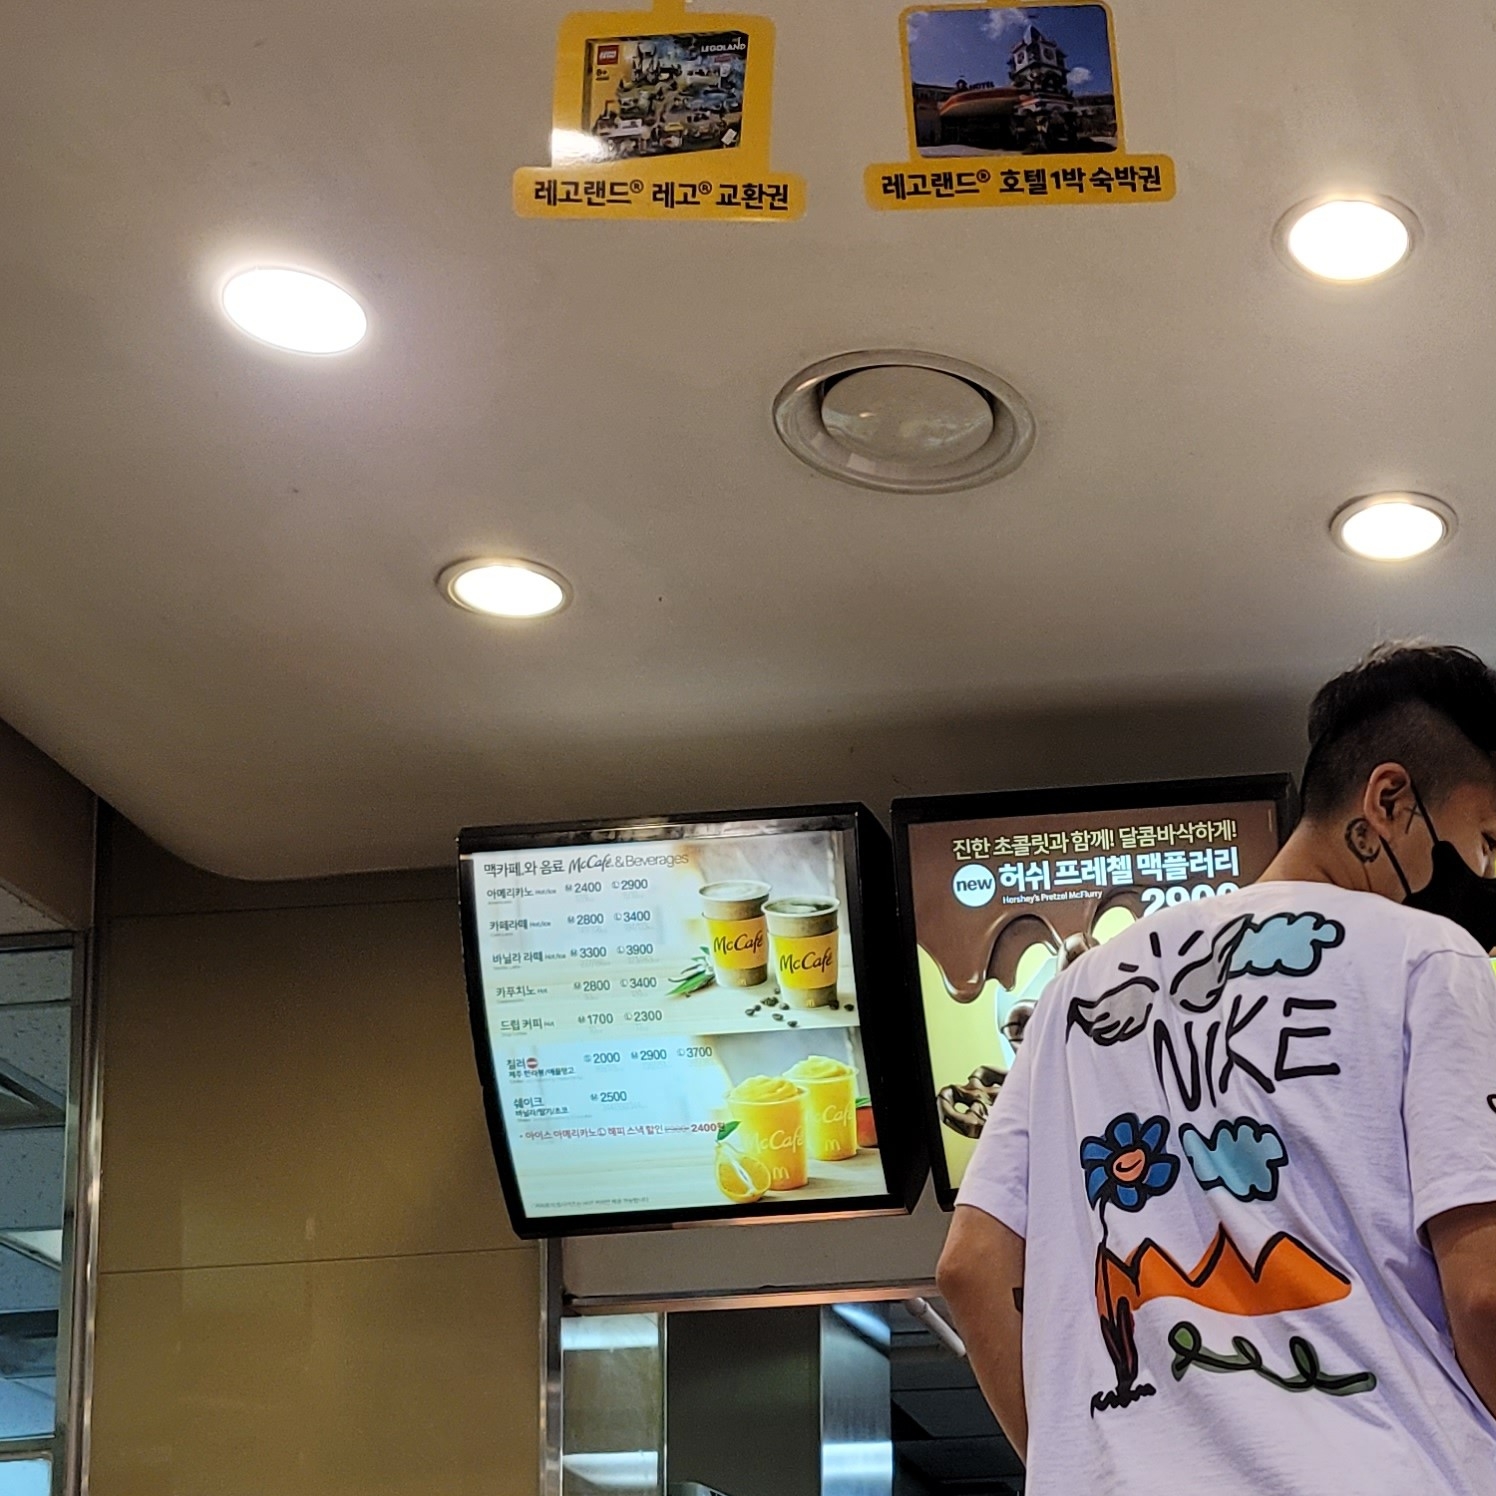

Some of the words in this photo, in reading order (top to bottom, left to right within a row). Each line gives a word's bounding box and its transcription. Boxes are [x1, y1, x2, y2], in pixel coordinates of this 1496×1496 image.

[1000, 168, 1048, 195] 호텔
[1050, 169, 1086, 194] 1박
[1089, 166, 1161, 195] 숙박권
[715, 183, 789, 211] 교환권
[952, 836, 991, 861] 진한
[992, 833, 1069, 857] 초콜릿과
[1071, 828, 1115, 852] 함께!
[1118, 818, 1238, 849] 달콤바삭하게!
[540, 860, 564, 875] 음료
[625, 853, 689, 868] Beverages
[998, 859, 1050, 892] 허쉬
[1053, 853, 1134, 886] 프레첼
[1136, 846, 1239, 882] 맥플러리
[487, 887, 534, 899] 아메리카노
[574, 882, 602, 893] 2400
[621, 879, 649, 890] 2900
[956, 875, 993, 892] new
[1002, 893, 1040, 905] Hershey's
[1040, 891, 1068, 902] Pretzel
[1068, 890, 1102, 900] McFlurry
[489, 919, 528, 931] 카페라떼
[577, 913, 604, 925] 2800
[623, 910, 651, 922] 3400
[713, 931, 763, 954] McCafé
[492, 952, 521, 965] 바닐라
[523, 951, 543, 962] 라떼
[579, 946, 607, 958] 3300
[626, 944, 653, 955] 3900
[779, 947, 834, 974] McCafé
[496, 985, 537, 997] 카푸치노
[583, 980, 610, 991] 2800
[629, 977, 657, 988] 3400
[500, 1019, 520, 1031] 드립
[522, 1018, 543, 1030] 커피
[587, 1013, 614, 1024] 1700
[634, 1010, 662, 1021] 2300
[593, 1052, 620, 1063] 2000
[640, 1049, 667, 1060] 2900
[686, 1046, 712, 1057] 3700
[1153, 994, 1341, 1111] NIKE
[600, 1091, 627, 1102] 2500
[525, 1131, 551, 1141] 아이스
